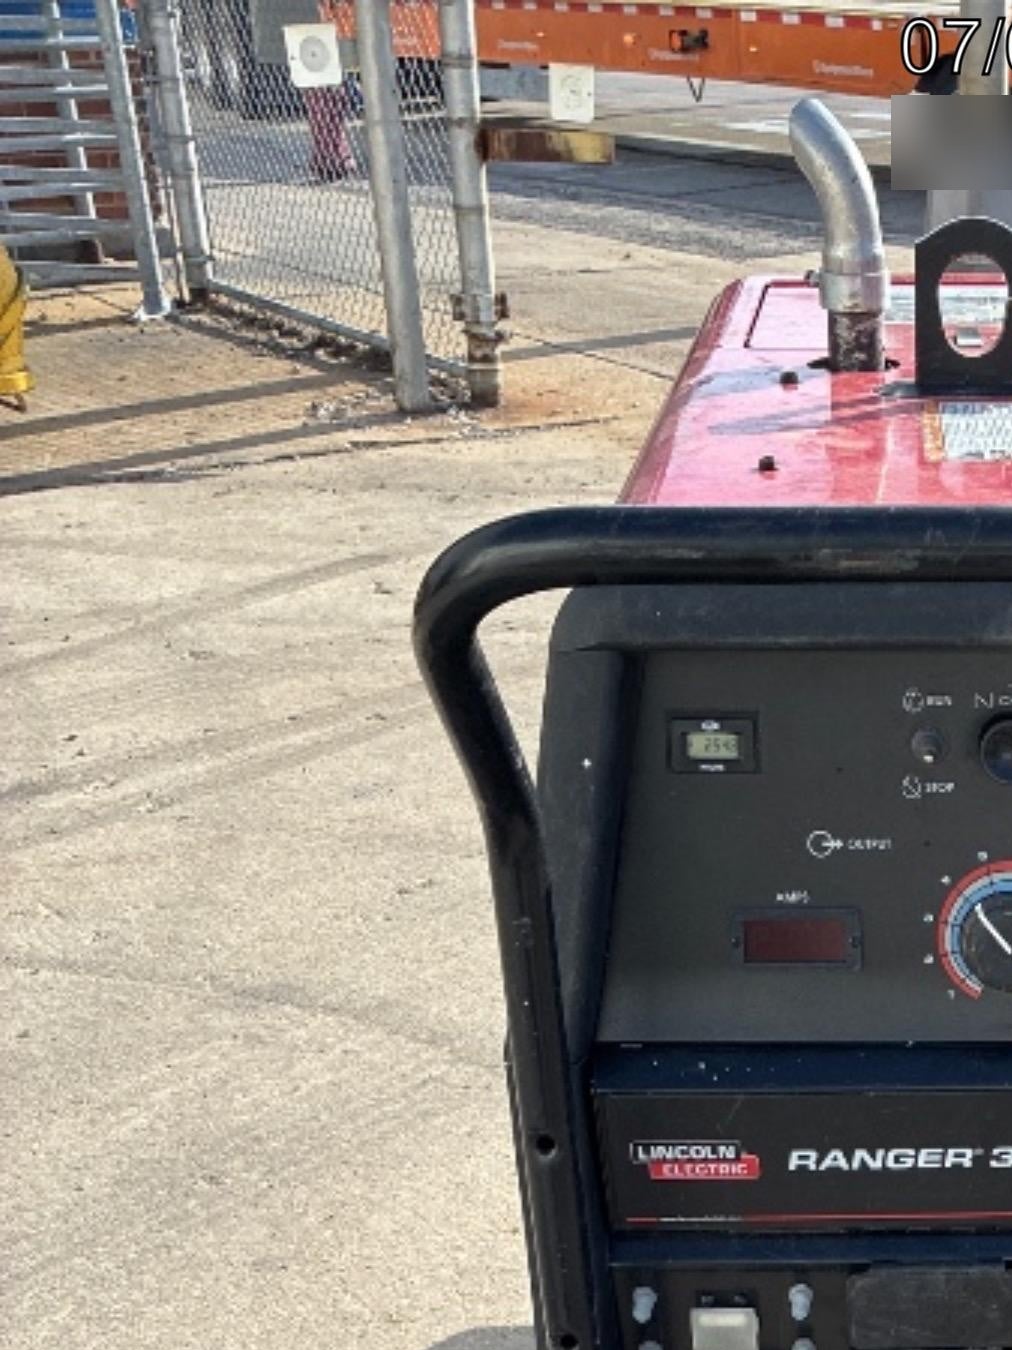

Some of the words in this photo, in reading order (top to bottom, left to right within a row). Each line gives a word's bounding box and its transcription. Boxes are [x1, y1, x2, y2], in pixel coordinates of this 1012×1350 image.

[637, 1145, 737, 1160] LINCOLN
[787, 1147, 976, 1172] RANGER
[661, 1163, 749, 1176] ELECTRIC
